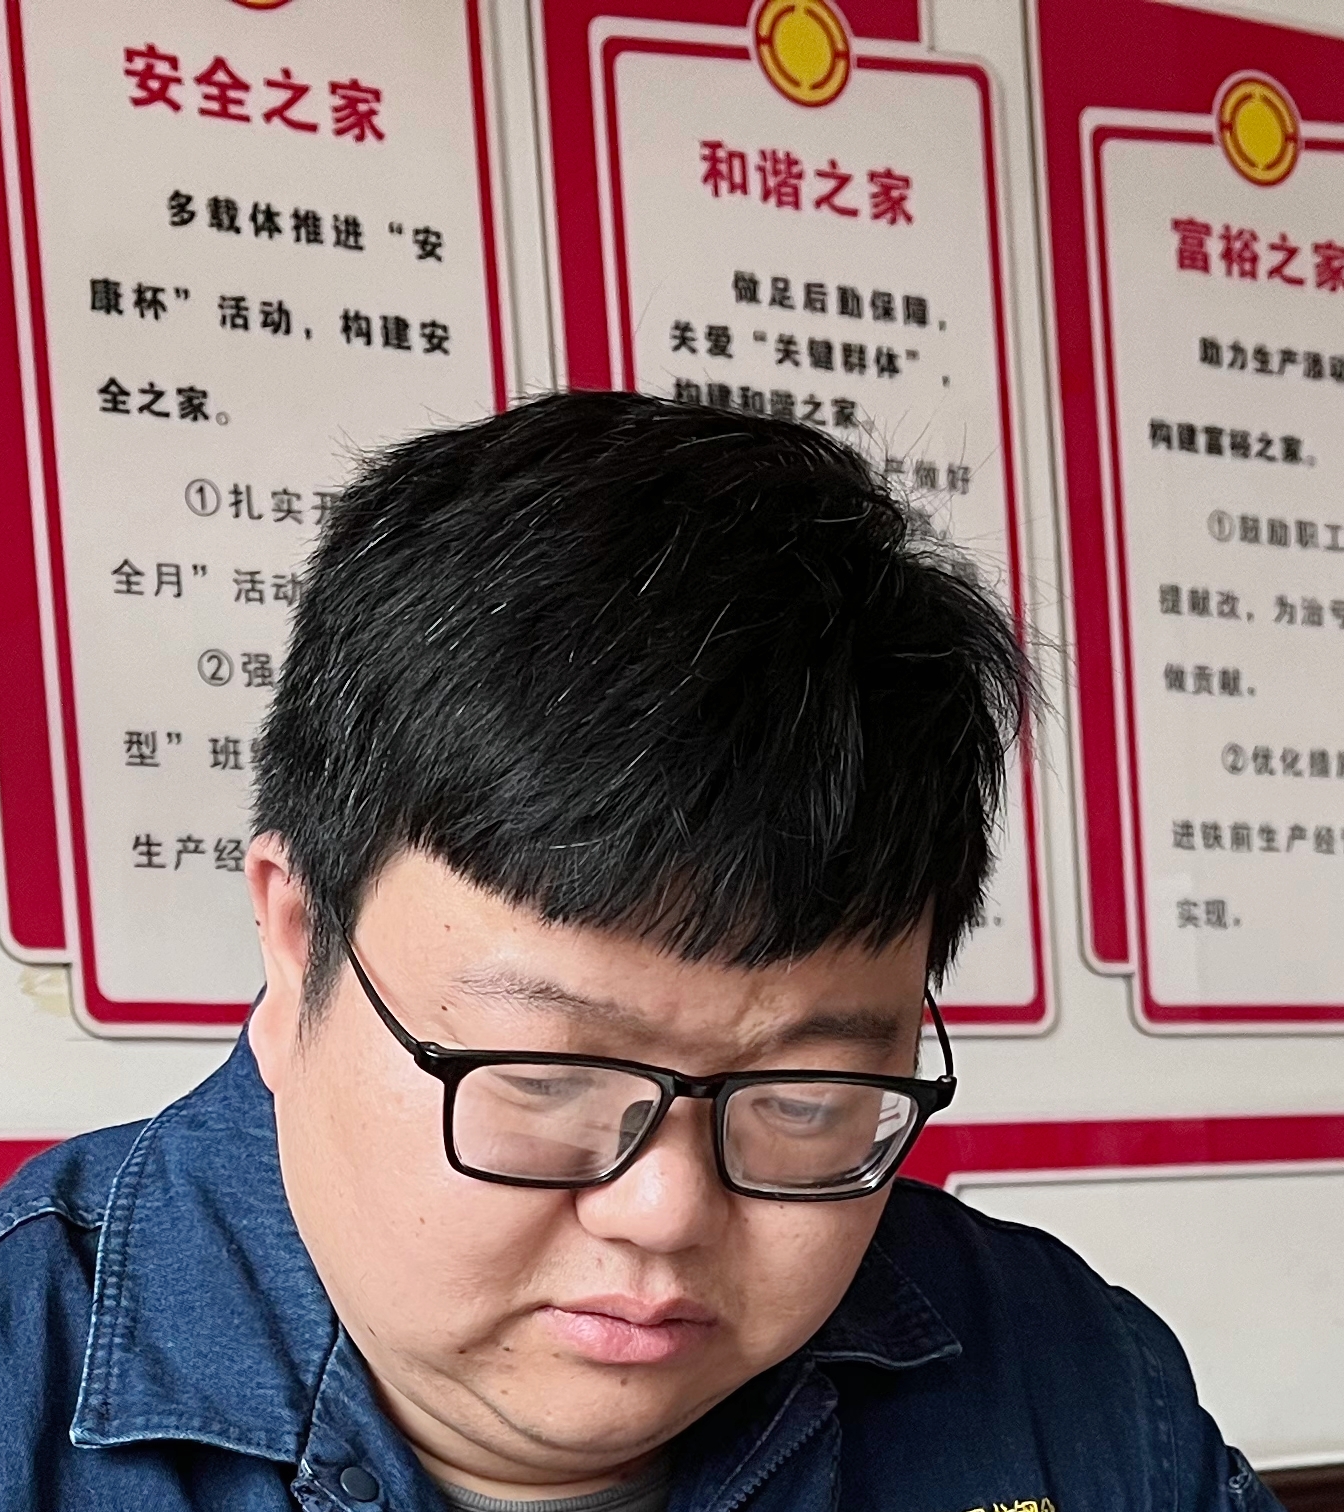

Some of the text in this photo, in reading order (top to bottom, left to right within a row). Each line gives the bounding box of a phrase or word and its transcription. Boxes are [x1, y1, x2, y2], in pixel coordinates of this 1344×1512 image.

[124, 43, 385, 142] 安全之家
[700, 140, 914, 226] 和谐之家
[97, 377, 230, 427] 全之家。
